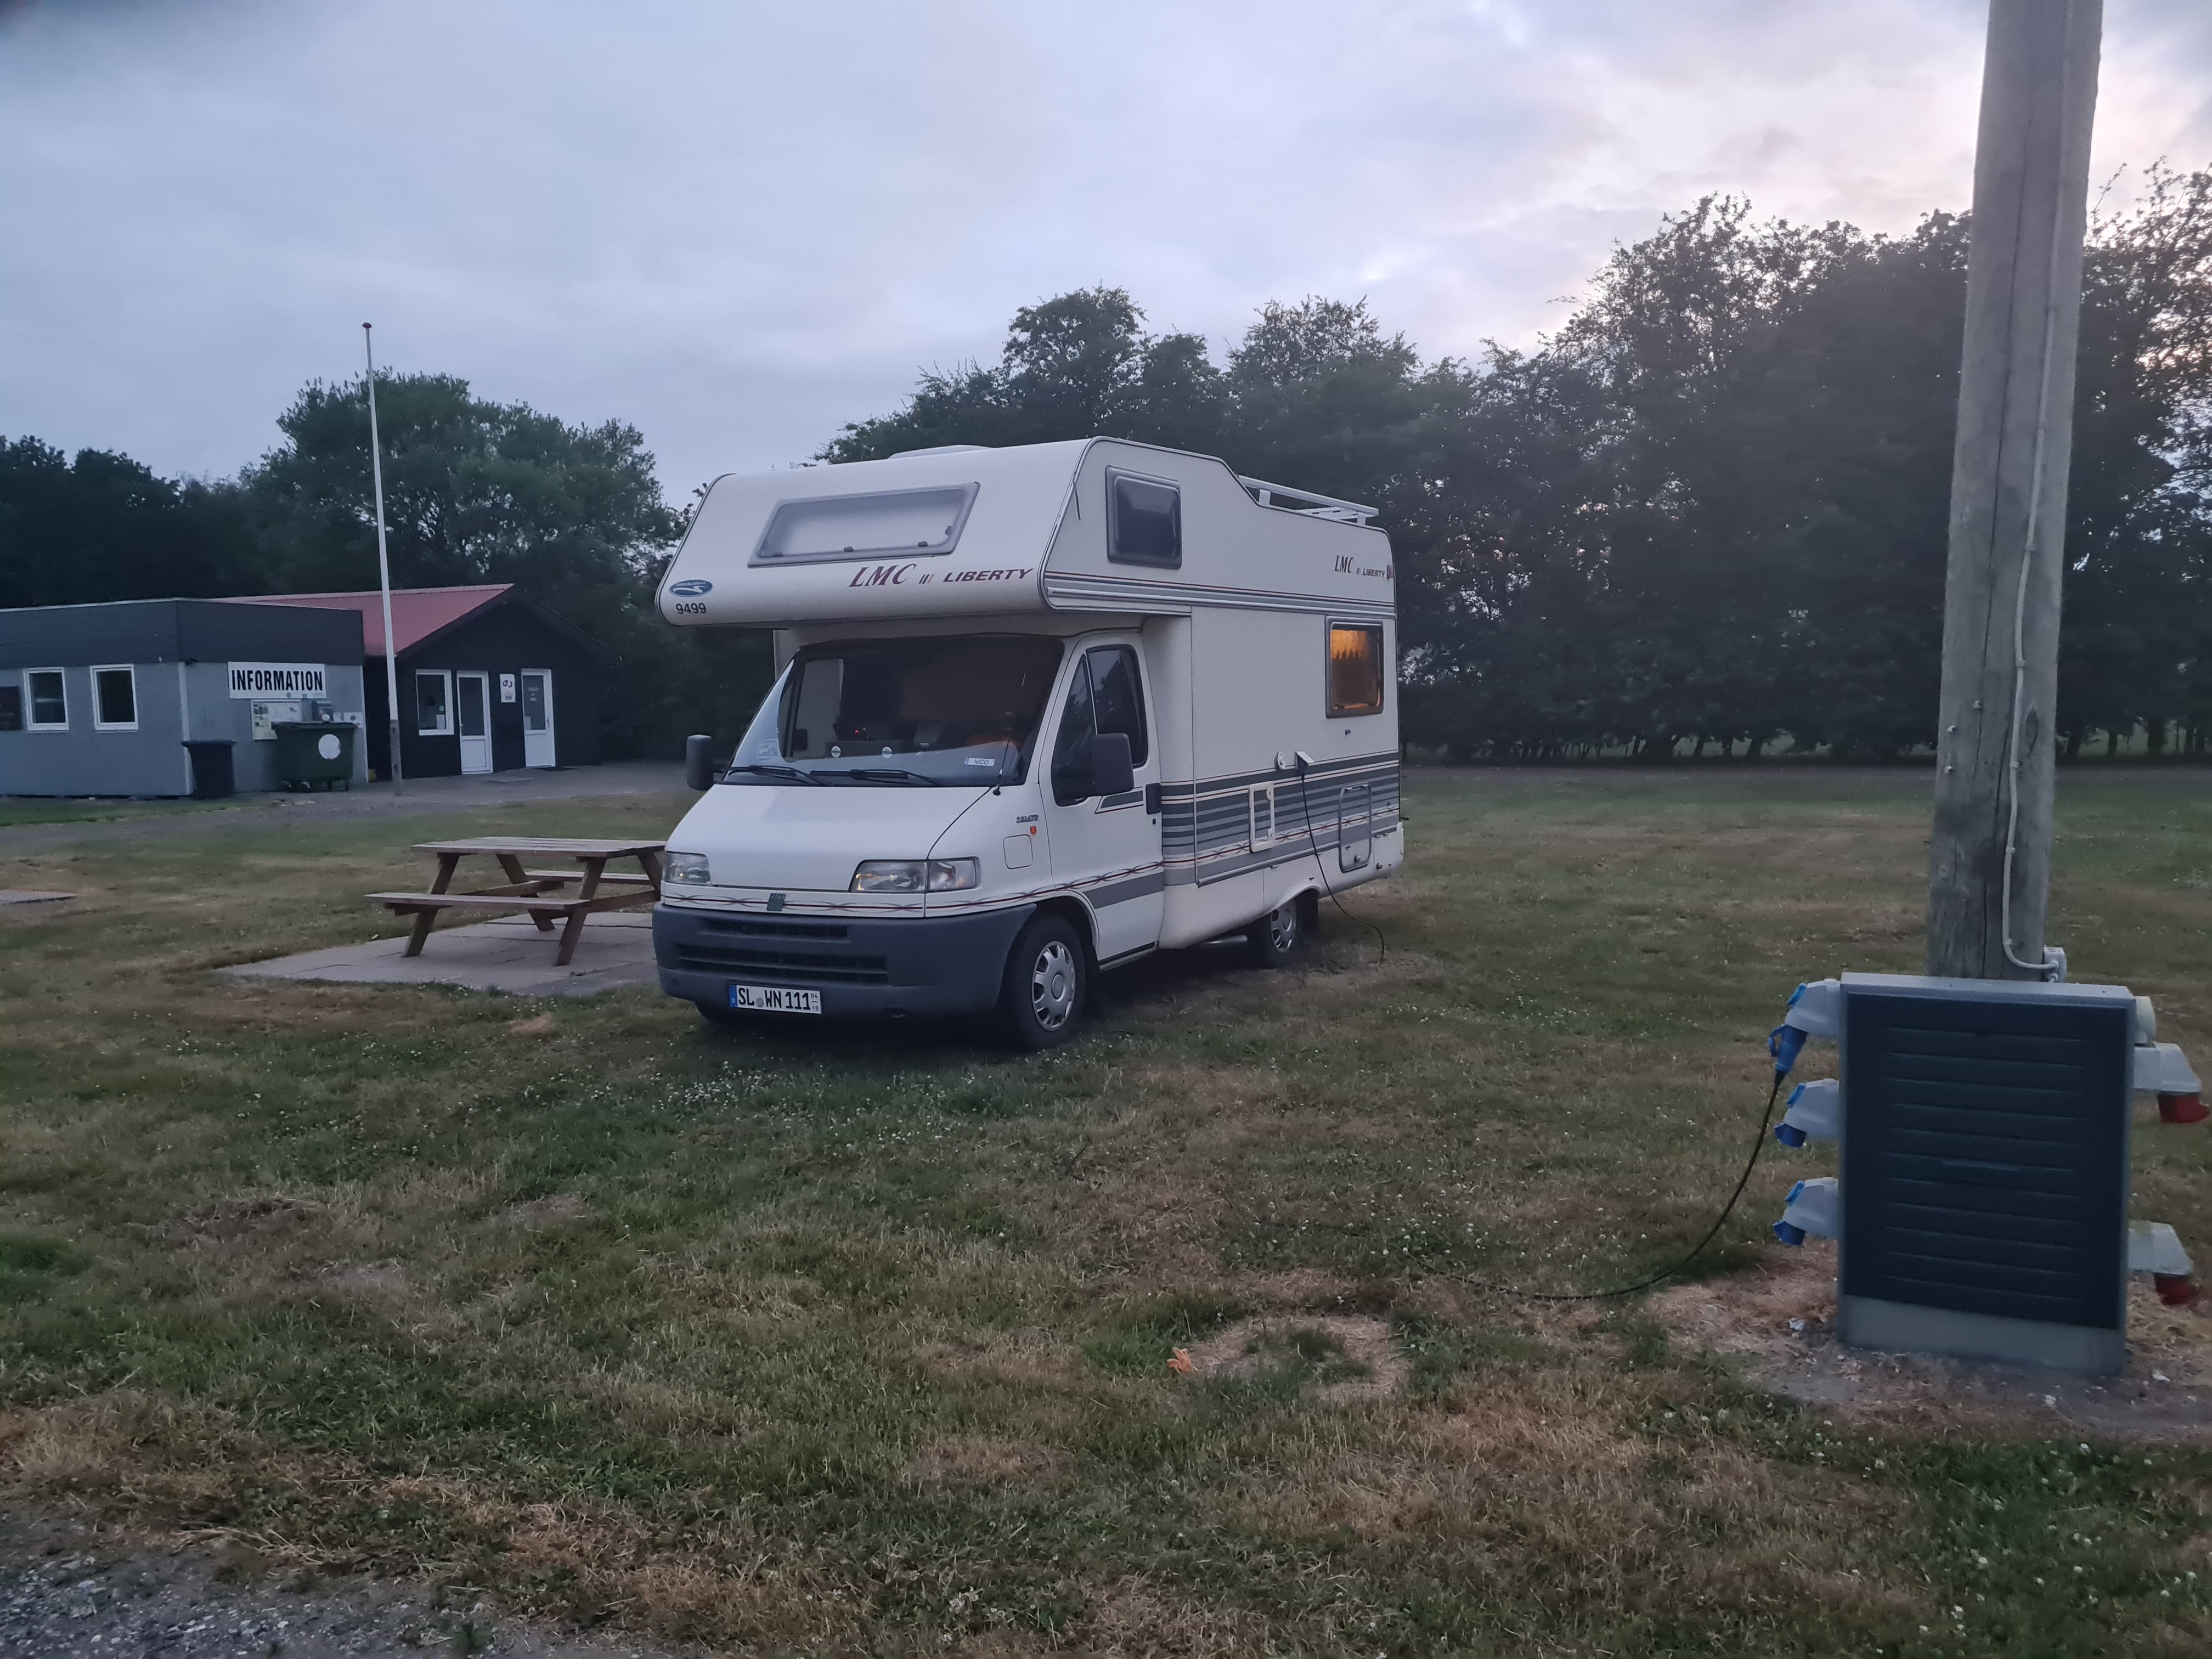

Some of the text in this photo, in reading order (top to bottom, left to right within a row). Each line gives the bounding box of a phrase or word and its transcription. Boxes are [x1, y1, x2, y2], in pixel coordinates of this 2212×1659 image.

[849, 563, 1034, 587] LMC LIBERTY
[1334, 555, 1385, 578] LMC LIBERTY
[675, 602, 707, 614] 9499
[232, 669, 323, 691] INFORMATION
[738, 988, 754, 1006] SL
[764, 990, 782, 1008] WN
[785, 991, 810, 1010] 111
